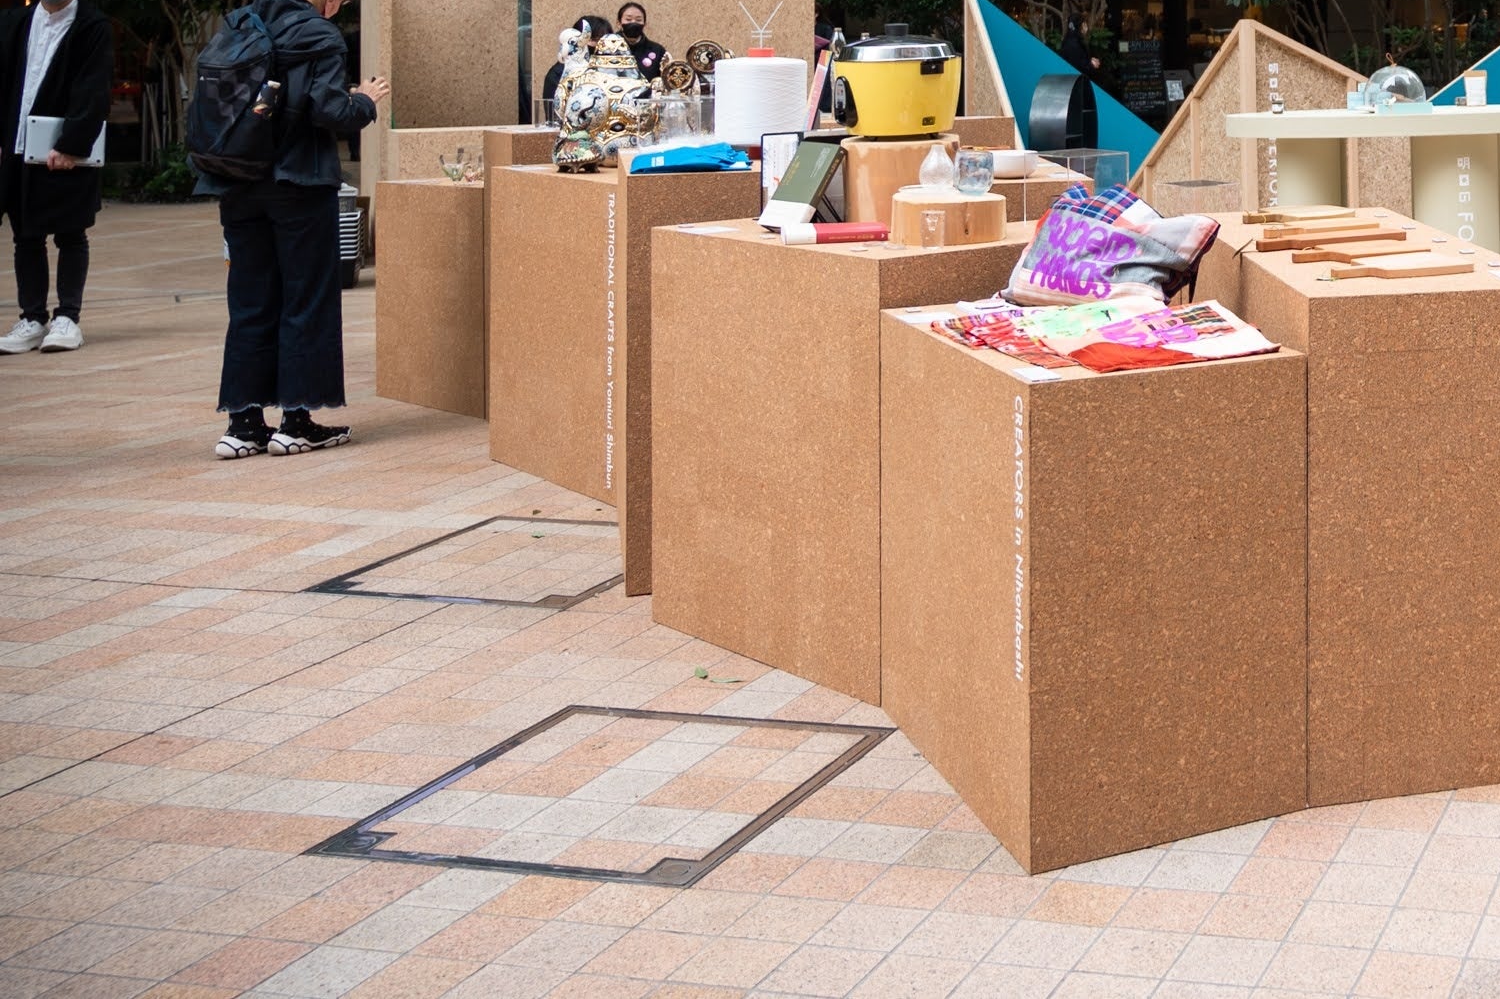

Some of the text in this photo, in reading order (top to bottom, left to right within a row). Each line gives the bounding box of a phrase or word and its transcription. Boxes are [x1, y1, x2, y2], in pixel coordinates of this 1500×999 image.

[607, 192, 615, 285] TRADITIONAL
[607, 291, 615, 343] CRAFTS
[606, 381, 614, 429] Yomiuri
[1013, 395, 1025, 681] CREATORS in Nihonbashi
